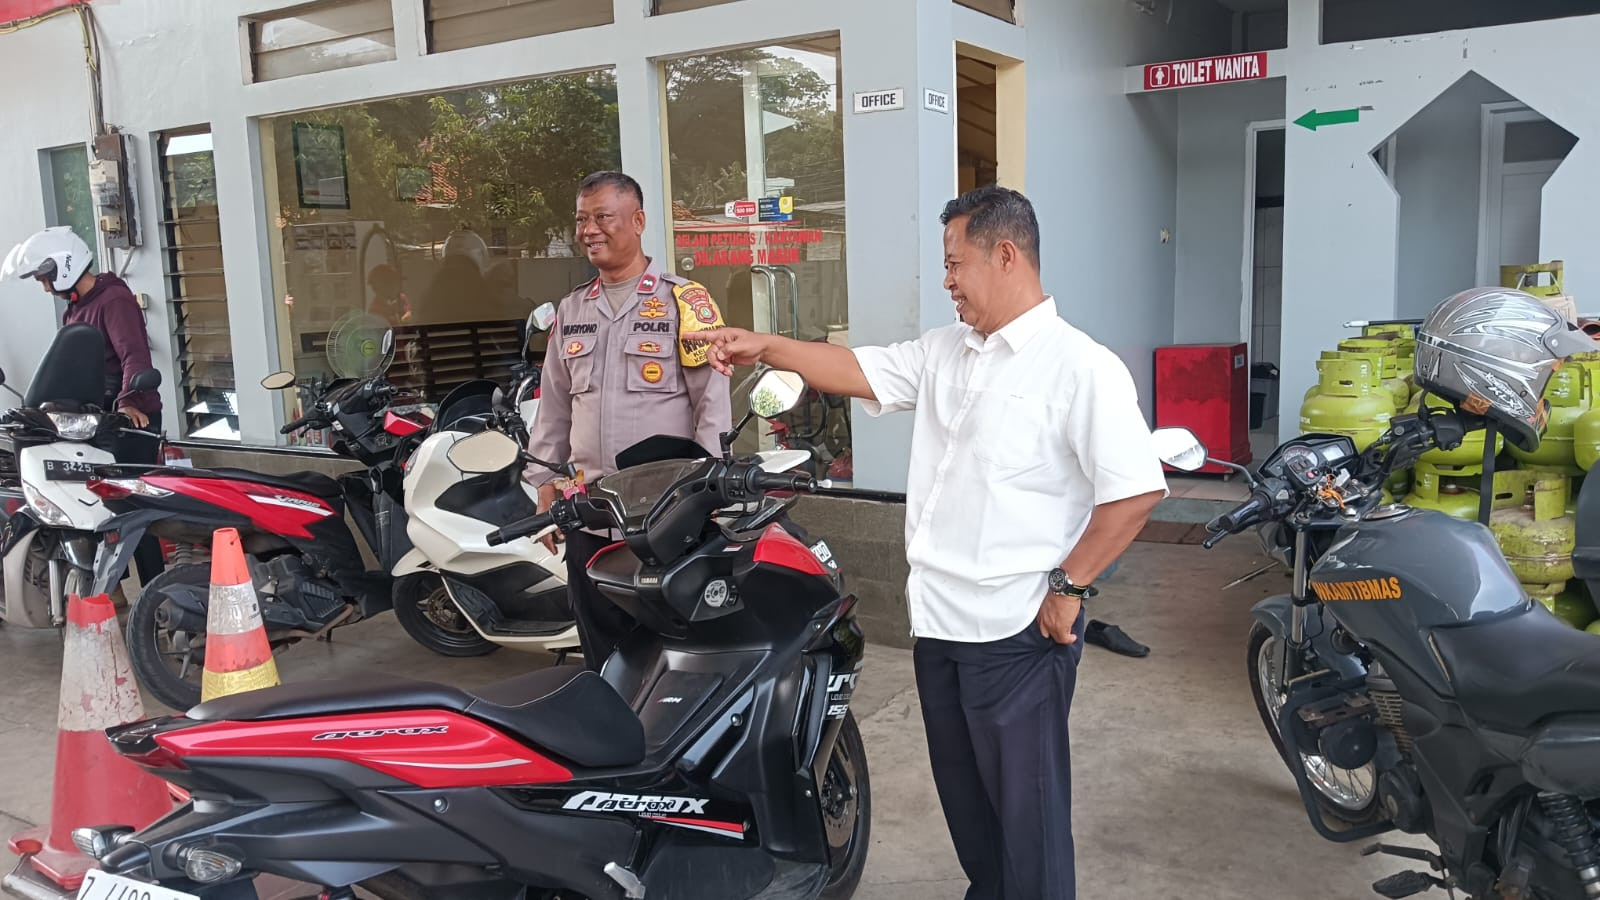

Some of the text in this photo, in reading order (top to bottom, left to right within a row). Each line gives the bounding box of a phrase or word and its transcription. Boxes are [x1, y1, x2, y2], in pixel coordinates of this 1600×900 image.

[1173, 56, 1259, 85] TOILET WANITA
[861, 93, 896, 108] OFFICE
[928, 93, 945, 108] OFFICE
[711, 231, 755, 246] PETUGAS
[765, 230, 823, 244] KARYAWAN
[694, 248, 800, 266] DILARANG MASUK
[633, 322, 670, 332] POLRI
[46, 461, 54, 471] B
